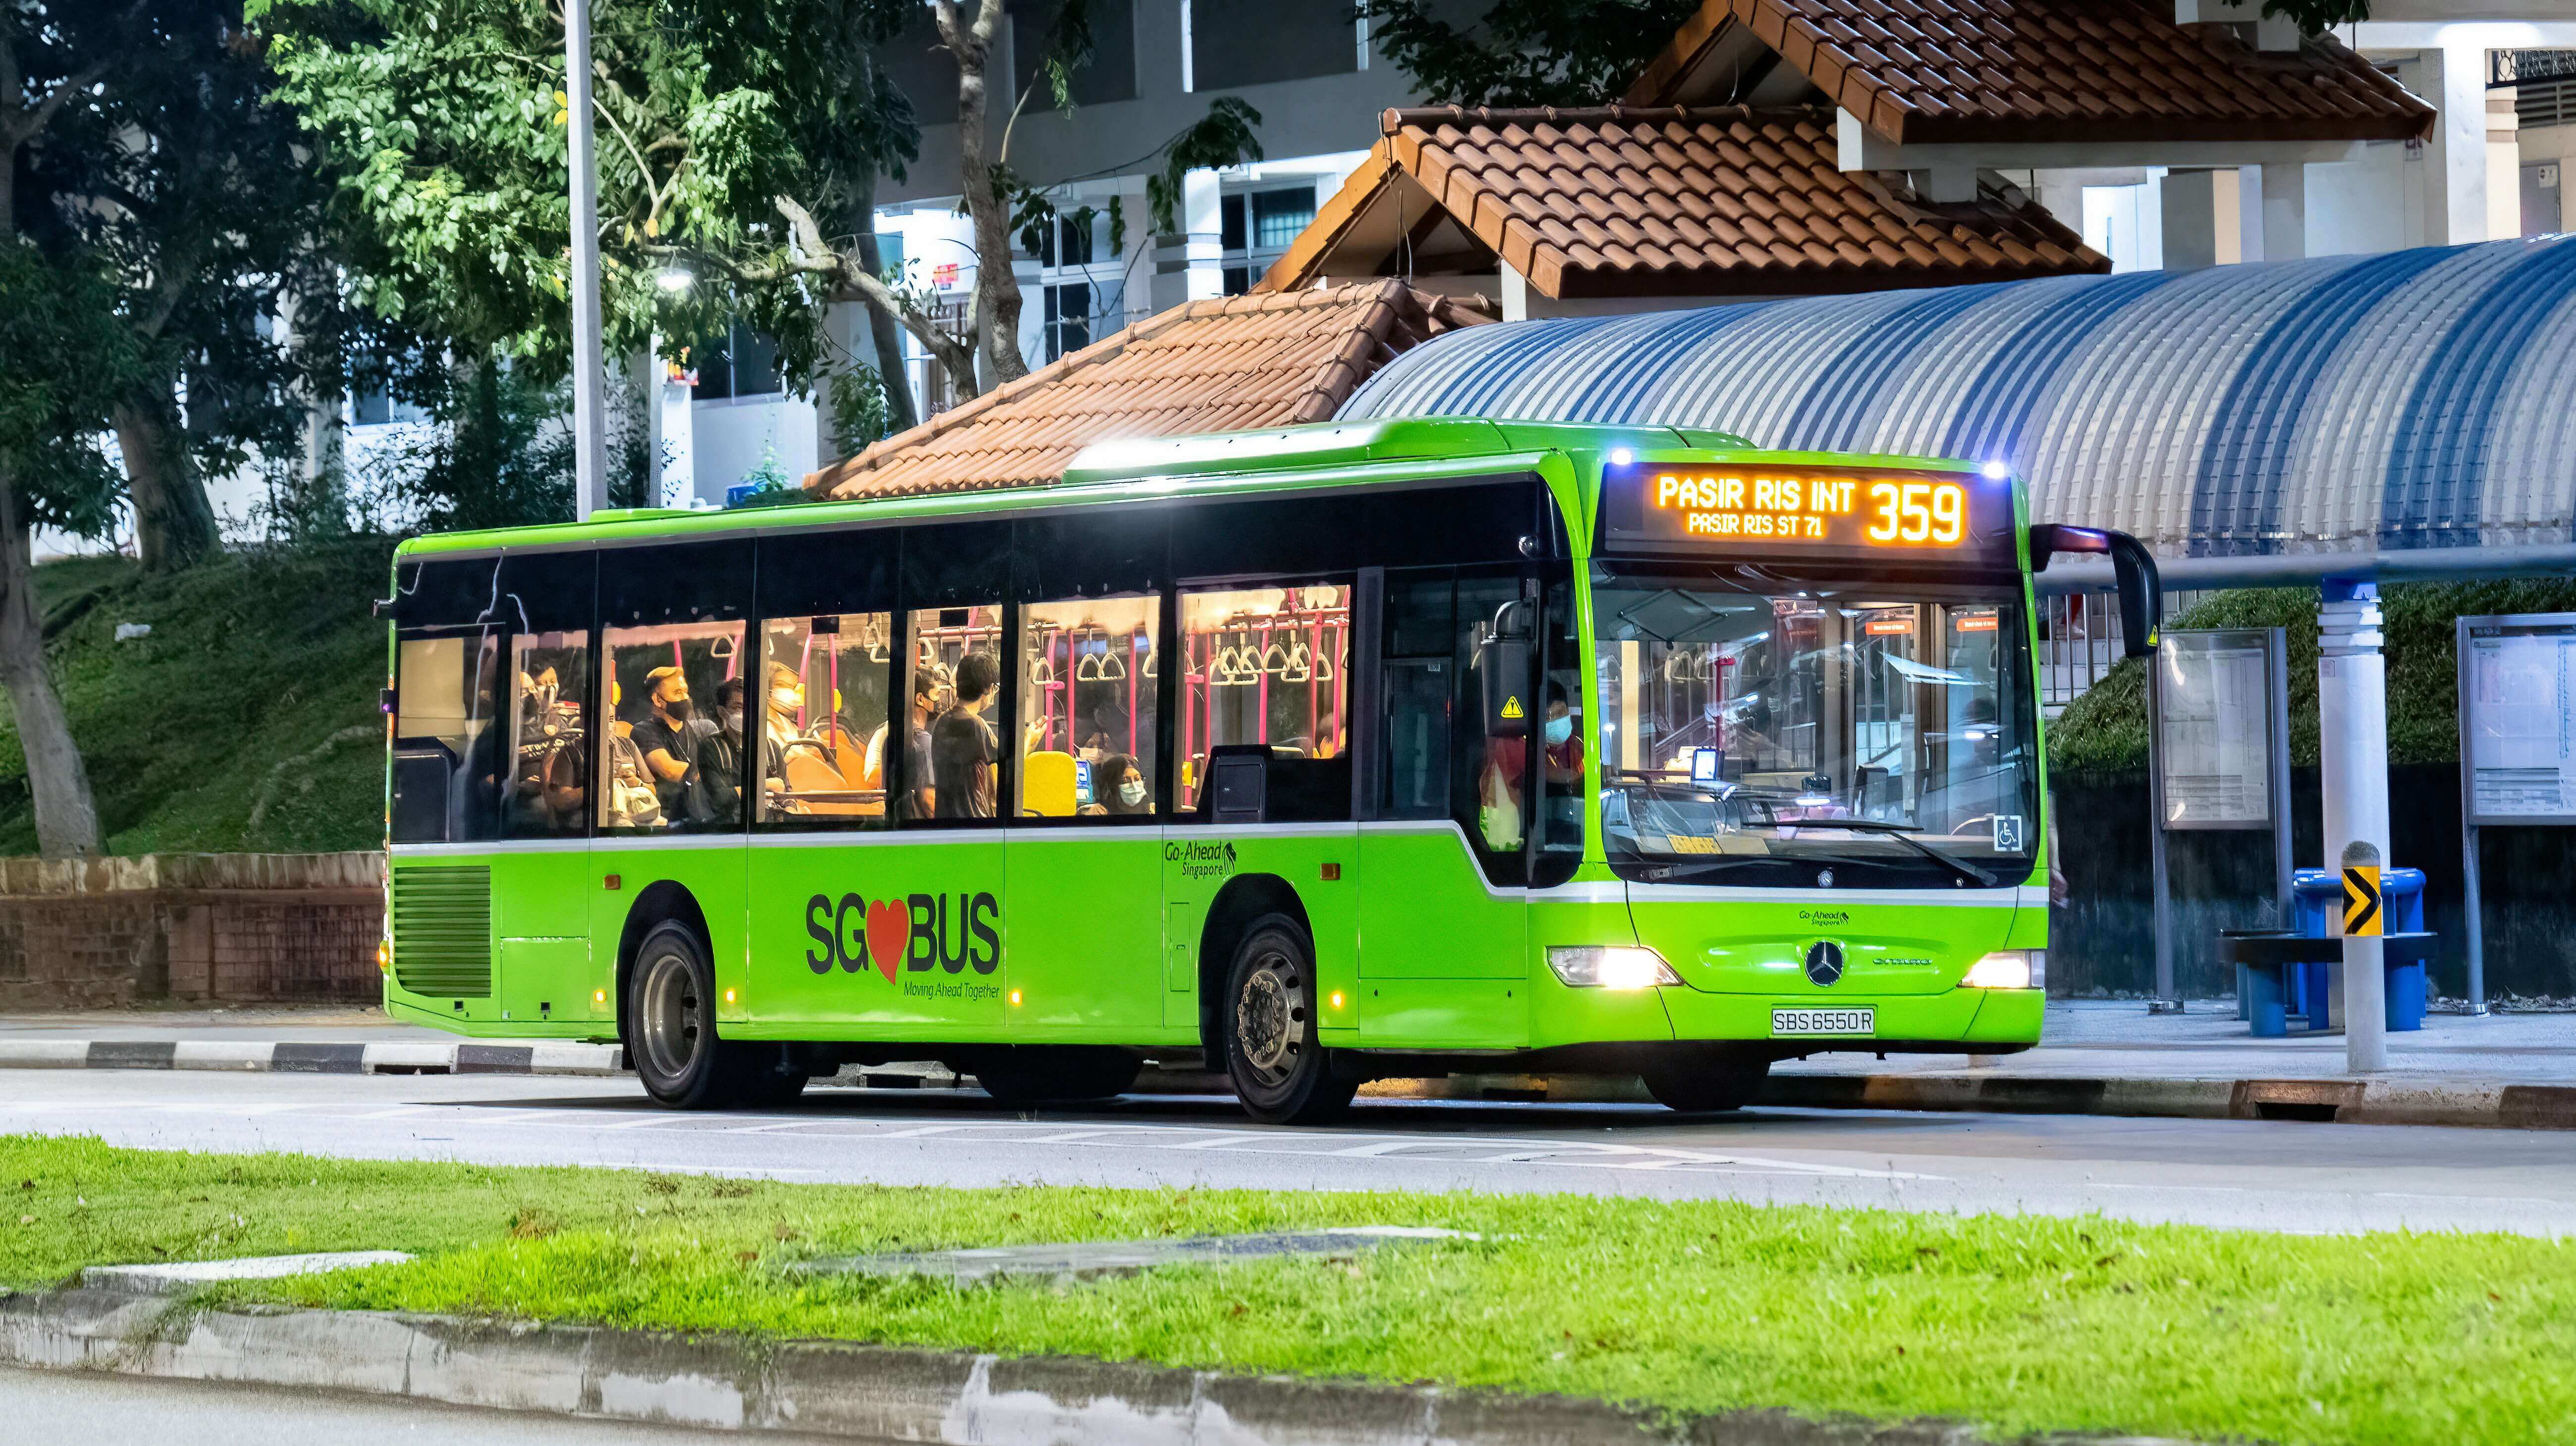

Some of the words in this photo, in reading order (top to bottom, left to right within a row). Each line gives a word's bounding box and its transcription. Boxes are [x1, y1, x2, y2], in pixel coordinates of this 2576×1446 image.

[1658, 476, 1744, 509] PASIR
[1755, 479, 1801, 511] RIS
[1811, 481, 1856, 513] INT
[1869, 483, 1962, 543] 359
[1689, 513, 1740, 534] PASIR
[1743, 514, 1773, 535] RIS
[1777, 515, 1800, 535] ST
[1804, 516, 1822, 536] 71
[1165, 840, 1222, 861] Go-Ahead
[1182, 862, 1224, 880] Singapore
[1799, 910, 1839, 919] Go-Ahead
[806, 892, 870, 975] SG
[907, 892, 1000, 975] BUS
[904, 981, 934, 998] Moving
[935, 982, 962, 997] Ahead
[964, 983, 1000, 1001] Together
